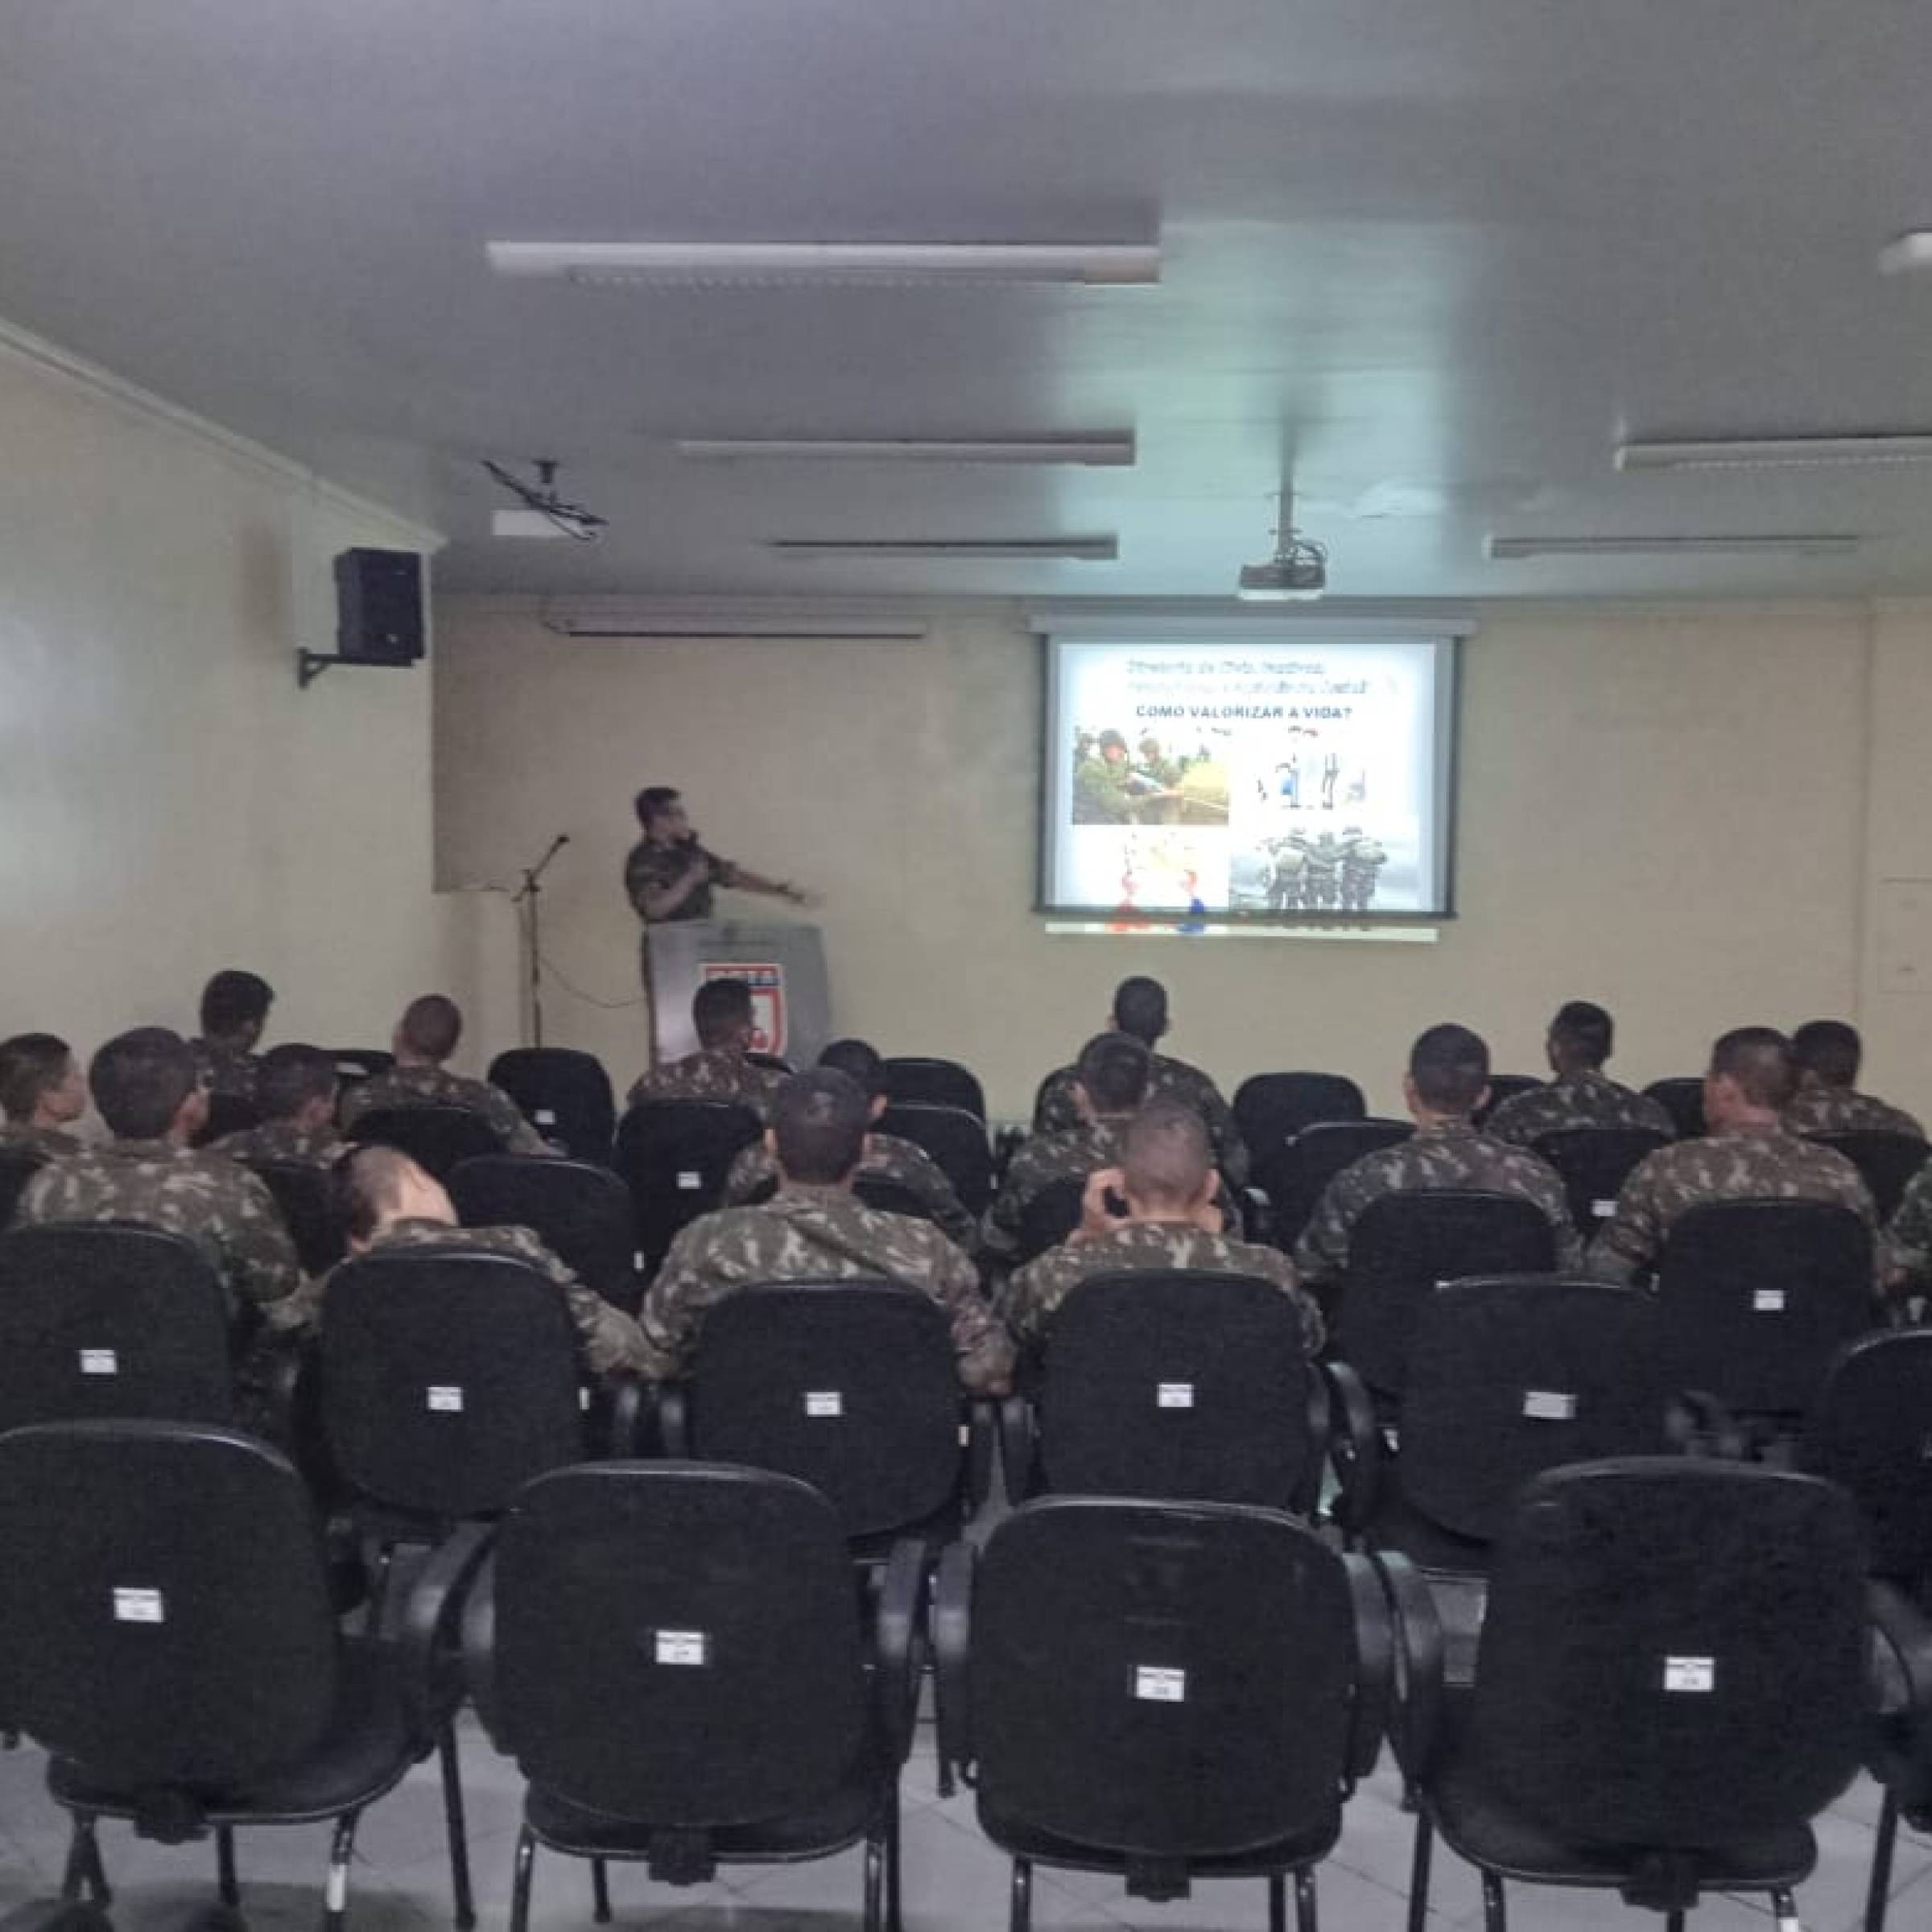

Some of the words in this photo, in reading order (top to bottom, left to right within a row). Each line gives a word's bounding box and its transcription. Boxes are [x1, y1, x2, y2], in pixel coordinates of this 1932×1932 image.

[1136, 705, 1184, 717] COMO
[1188, 705, 1284, 718] VALORIZAR
[1287, 706, 1299, 718] A
[1302, 706, 1353, 719] VIDA?
